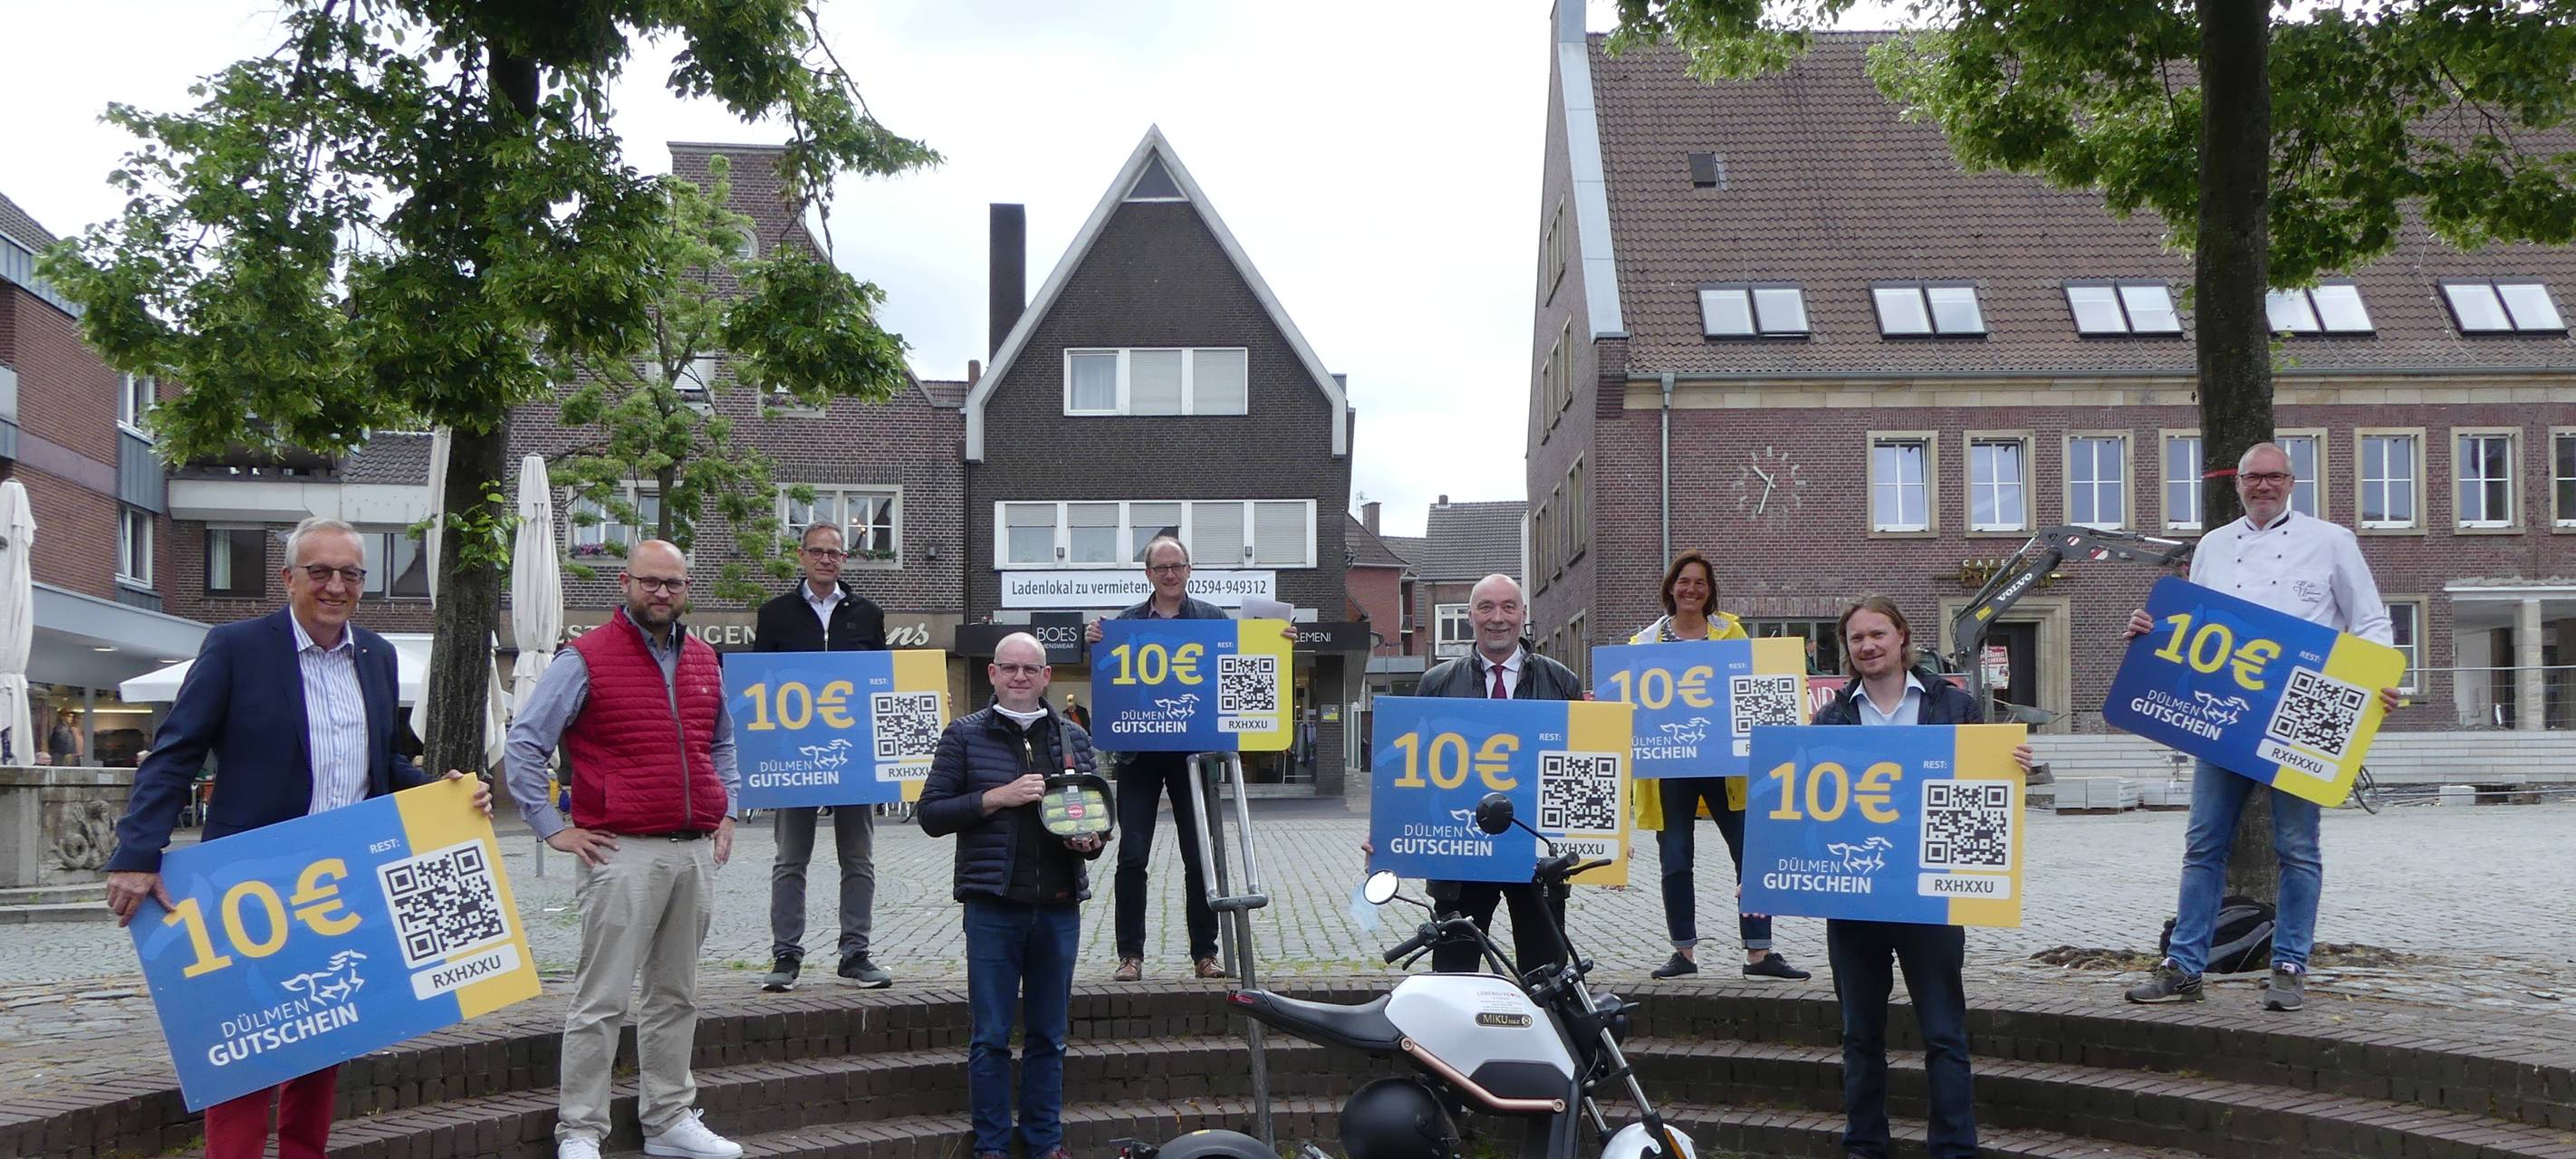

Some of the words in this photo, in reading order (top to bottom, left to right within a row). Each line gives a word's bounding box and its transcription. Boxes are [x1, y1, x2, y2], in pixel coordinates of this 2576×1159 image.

[1012, 580, 1073, 595] Ladenlokal
[1075, 584, 1088, 595] zu
[1090, 580, 1152, 595] vermieten!
[1187, 580, 1267, 595] 02594-949312
[1996, 572, 2033, 601] VOLVO
[884, 622, 930, 646] ns
[1036, 627, 1078, 642] BOES
[2154, 613, 2282, 691] 10€
[2299, 650, 2321, 663] REST:
[1110, 642, 1204, 685] 10€
[1610, 666, 1715, 710] 10€
[743, 680, 856, 731] 10€
[2147, 688, 2201, 716] DÜLMEN
[1121, 709, 1165, 721] DÜLMEN
[1228, 720, 1268, 729] RXHXXU
[2130, 697, 2222, 741] GUTSCHEIN
[1111, 721, 1187, 733] GUTSCHEIN
[1539, 733, 1562, 742] REST:
[1631, 735, 1672, 747] ÜLMEN
[1393, 732, 1520, 791] 10€
[1630, 745, 1697, 761] TSCHEIN
[2272, 747, 2323, 773] RXHXXU
[760, 758, 812, 772] DÜLMEN
[1923, 760, 1947, 770] REST:
[748, 771, 840, 788] GUTSCHEIN
[1769, 761, 1902, 824] 10€
[1404, 821, 1464, 838] DÜLMEN
[370, 838, 401, 854] REST:
[1390, 838, 1493, 857] GUTSCHEIN
[1778, 857, 1841, 874] DÜLMEN
[1763, 873, 1871, 894] GUTSCHEIN
[1934, 878, 1994, 894] RXHXXU
[161, 857, 362, 979] 10€
[432, 953, 502, 989] RXHXXU
[221, 997, 311, 1039] DÜLMEN
[207, 1001, 359, 1067] GUTSCHEIN
